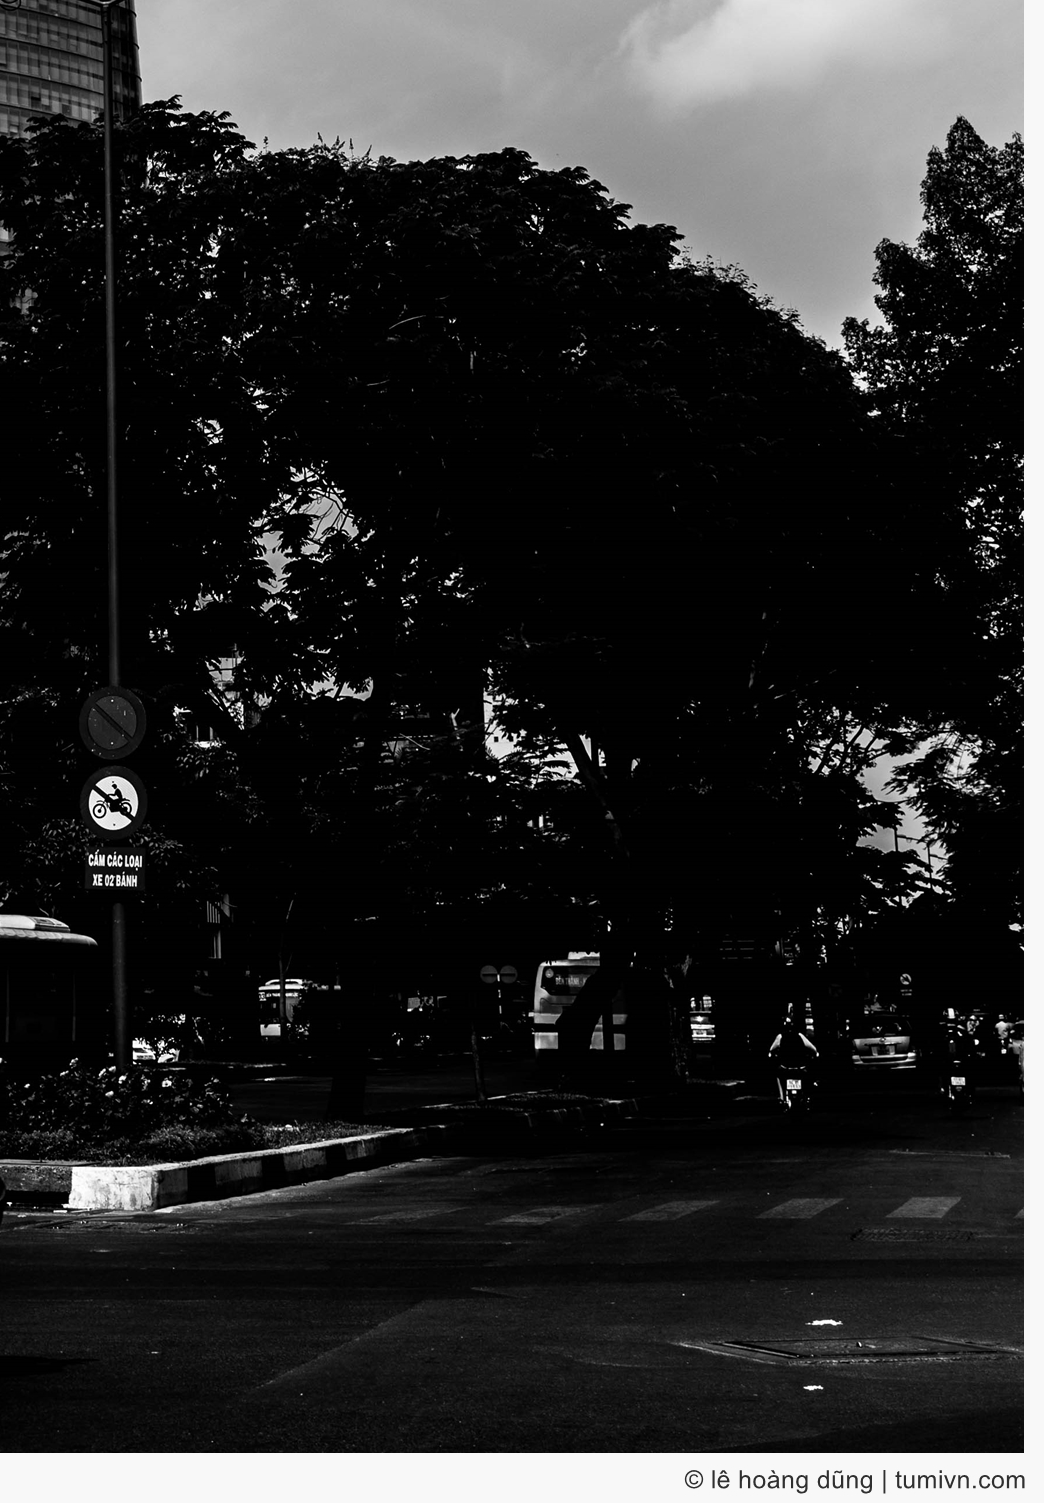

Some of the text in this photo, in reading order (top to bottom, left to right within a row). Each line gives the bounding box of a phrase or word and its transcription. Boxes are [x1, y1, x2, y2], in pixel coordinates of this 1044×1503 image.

[88, 849, 143, 871] CẤM CÁC LOẠI
[92, 871, 138, 887] XE 02 BÁNH
